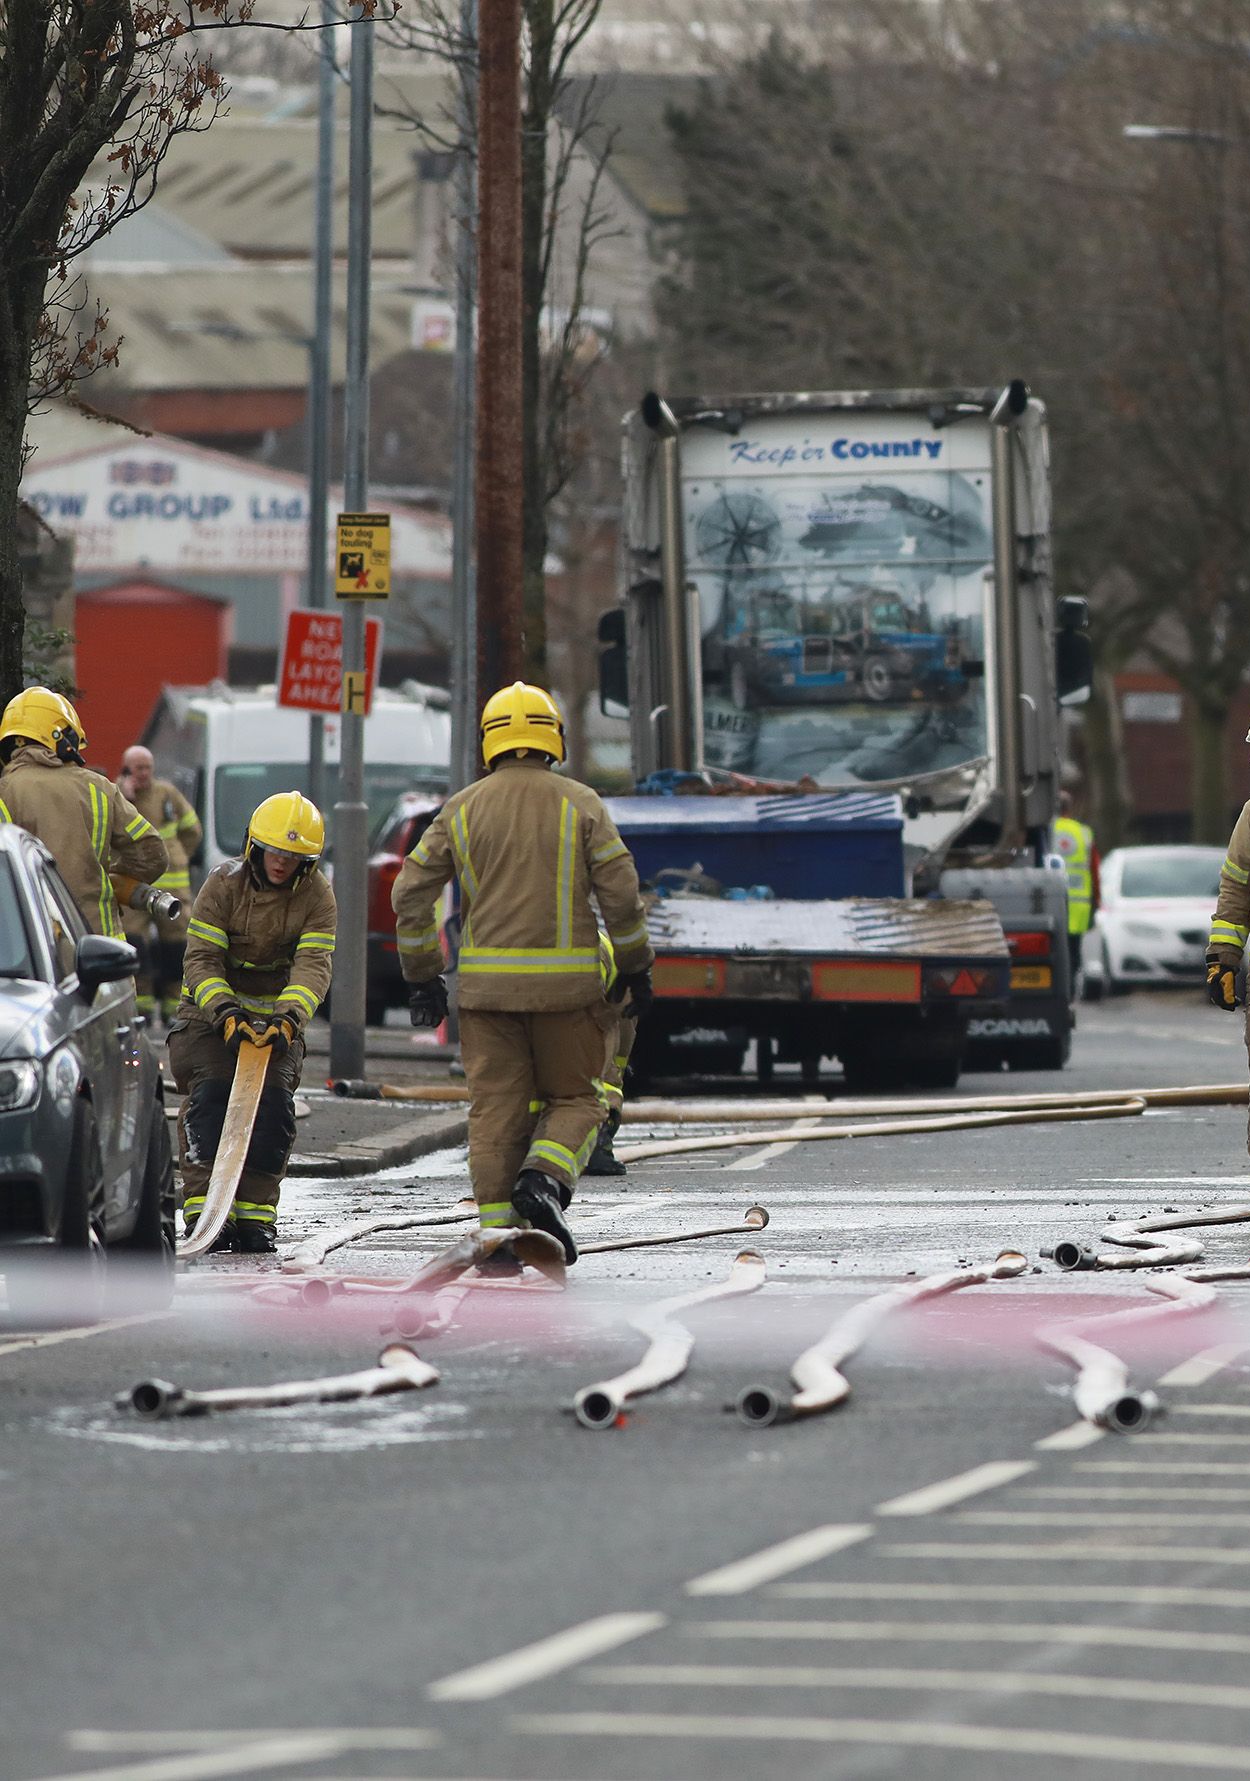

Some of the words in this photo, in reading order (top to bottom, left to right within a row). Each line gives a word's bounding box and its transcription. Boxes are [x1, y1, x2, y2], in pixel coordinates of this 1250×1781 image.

[831, 438, 943, 459] County
[108, 493, 232, 520] GROUP
[340, 529, 353, 538] No
[355, 528, 373, 540] dog
[340, 539, 373, 550] fouling
[308, 620, 339, 638] NE
[288, 661, 342, 684] LAYO
[967, 1018, 1051, 1036] SCANIA
